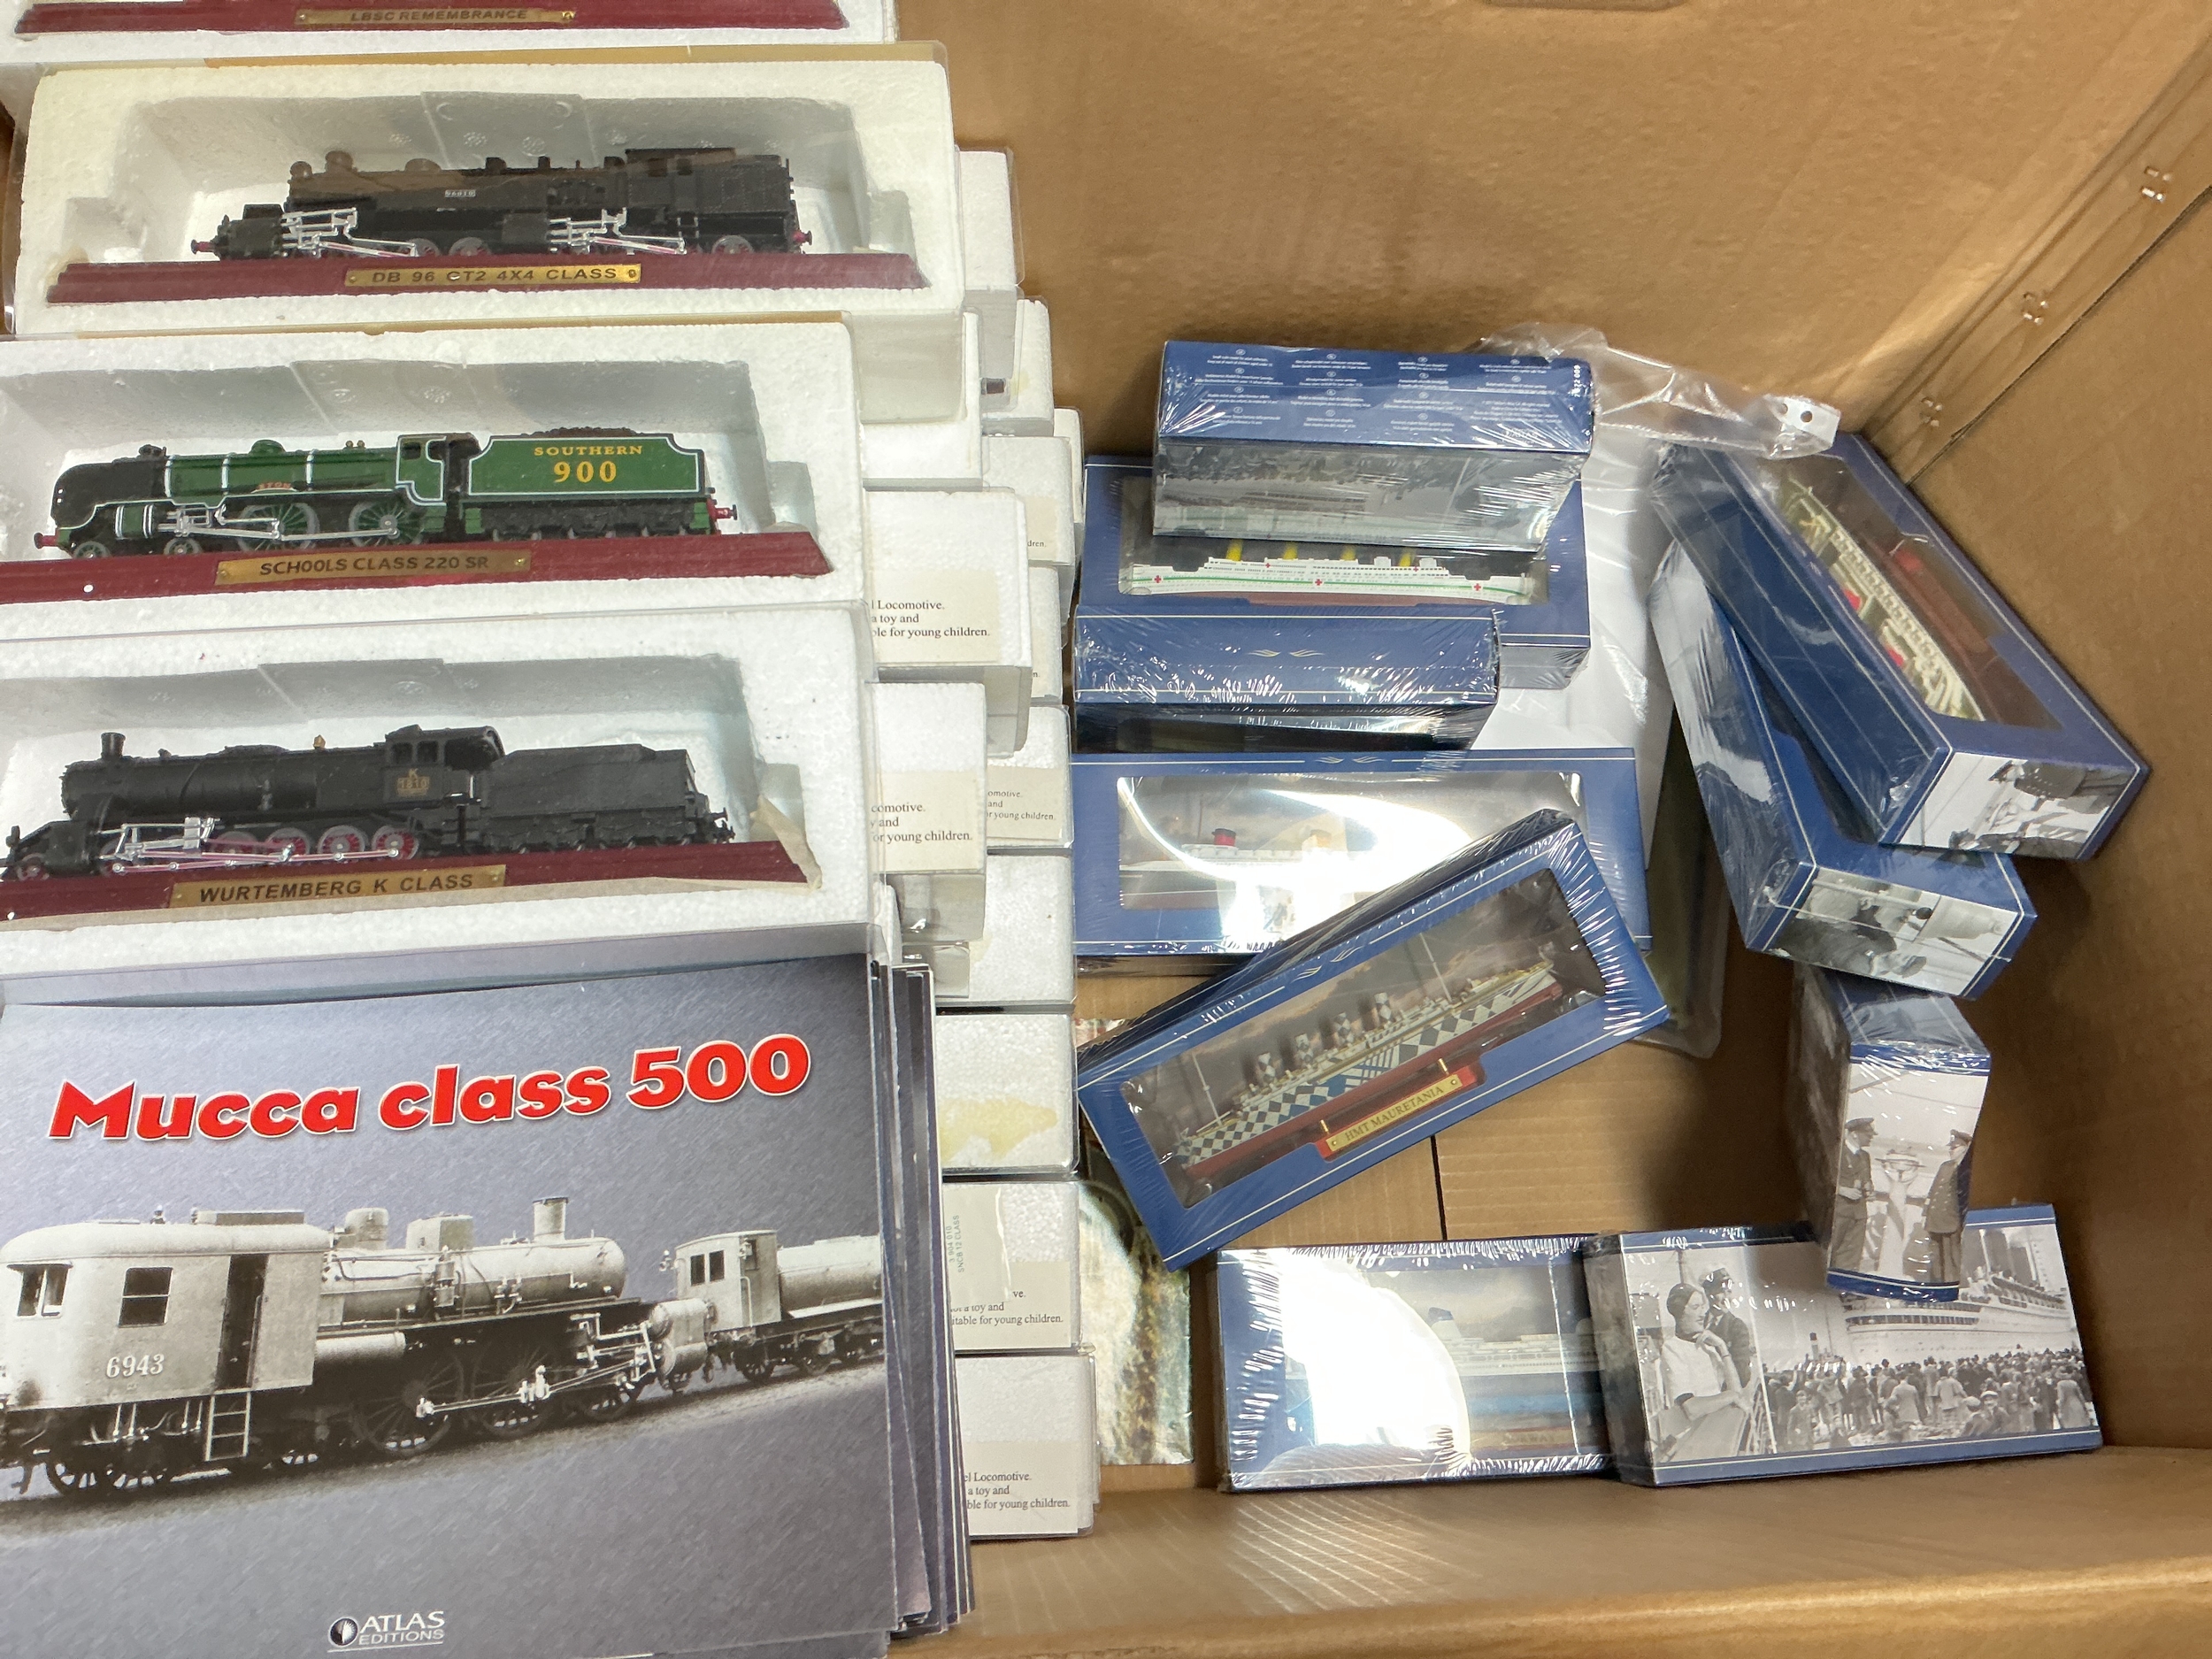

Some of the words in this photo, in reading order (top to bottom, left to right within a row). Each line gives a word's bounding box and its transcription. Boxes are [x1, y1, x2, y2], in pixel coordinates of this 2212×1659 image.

[351, 10, 395, 21] LBSC
[399, 9, 527, 21] REMEMBRANCE
[372, 272, 401, 283] DB
[411, 271, 435, 282] 96
[496, 269, 534, 280] 4X4
[546, 268, 618, 280] CLASS
[534, 445, 643, 457] SOUTHERN
[553, 460, 617, 483] 900
[259, 558, 348, 576] SCHOOLS
[353, 557, 419, 572] CLASS
[424, 556, 460, 569] 220
[465, 556, 488, 569] SR
[877, 599, 945, 611] Locomotive.
[879, 614, 897, 626] toy
[899, 613, 919, 623] and
[889, 626, 906, 637] for
[907, 628, 941, 639] young
[943, 626, 991, 637] children.
[879, 817, 899, 827] and
[994, 812, 1019, 821] young
[887, 833, 922, 845] young
[925, 830, 973, 841] children.
[200, 879, 361, 902] WURTEMBERG
[373, 879, 389, 894] K
[400, 873, 474, 892] CLASS
[49, 1078, 361, 1141] Mucca
[377, 1064, 611, 1132] class
[626, 1033, 812, 1110] 500
[1344, 1123, 1371, 1141] HMT
[1372, 1086, 1444, 1128] MAURETANIA
[952, 1215, 962, 1240] CLASS
[987, 1302, 1005, 1311] and
[979, 1315, 993, 1325] for
[994, 1316, 1023, 1326] young
[1024, 1314, 1064, 1324] children.
[106, 1354, 165, 1378] 6943
[973, 1471, 1033, 1482] Locomotive.
[975, 1486, 991, 1497] toy
[992, 1485, 1010, 1495] and
[983, 1499, 997, 1509] for
[999, 1501, 1028, 1511] young
[1030, 1498, 1071, 1508] children.
[359, 1610, 445, 1634] ATLAS
[358, 1629, 445, 1646] EDITIONS
